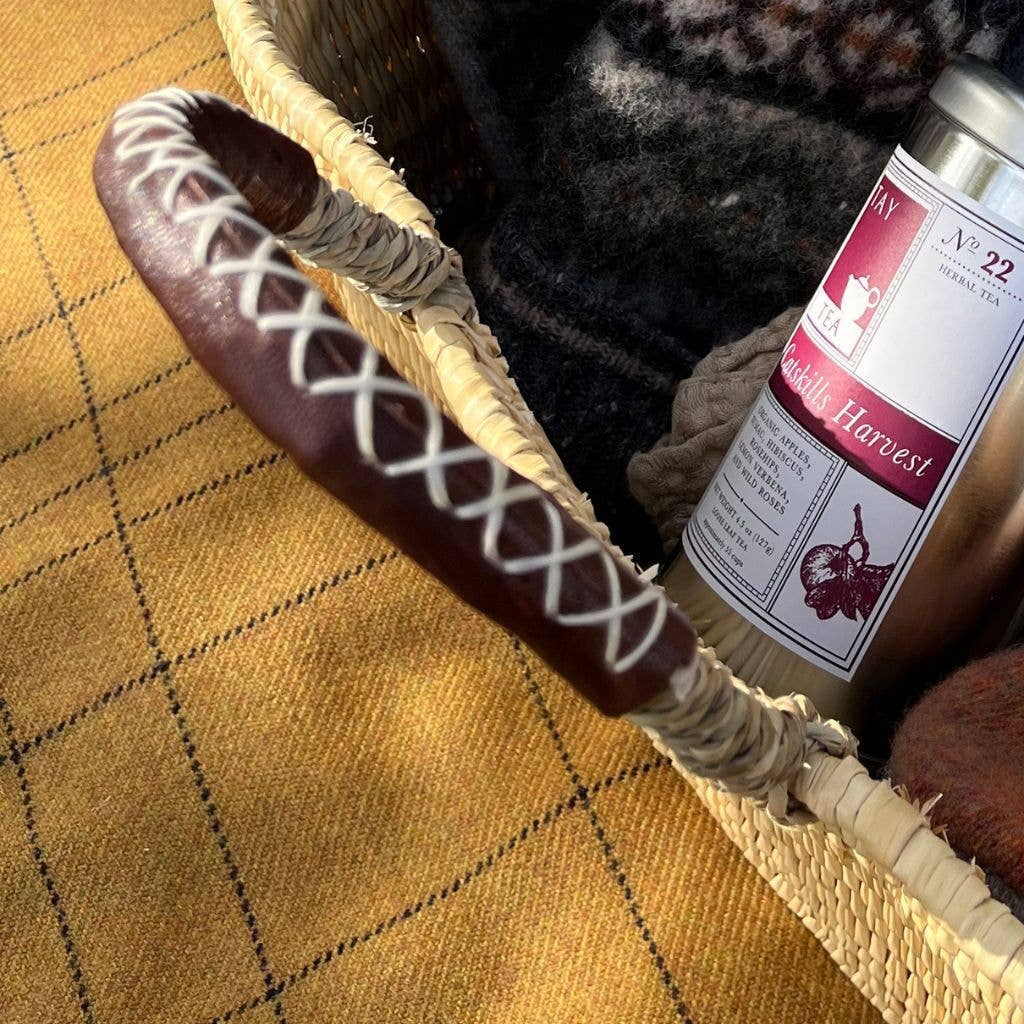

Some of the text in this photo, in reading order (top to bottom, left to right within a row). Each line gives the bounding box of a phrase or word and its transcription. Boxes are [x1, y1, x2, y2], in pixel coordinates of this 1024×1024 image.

[871, 185, 900, 220] TAY
[939, 264, 1000, 307] HERBAL TEA
[980, 251, 1015, 284] 22
[817, 302, 841, 337] TEA
[781, 343, 933, 477] Catskills Harvest
[750, 437, 780, 478] ROSEHIPS,
[766, 438, 804, 481] HIBISCUS,
[779, 435, 811, 469] APPLES,
[741, 466, 758, 489] WILD
[758, 487, 786, 515] ROSES
[753, 462, 789, 504] VERBENA,
